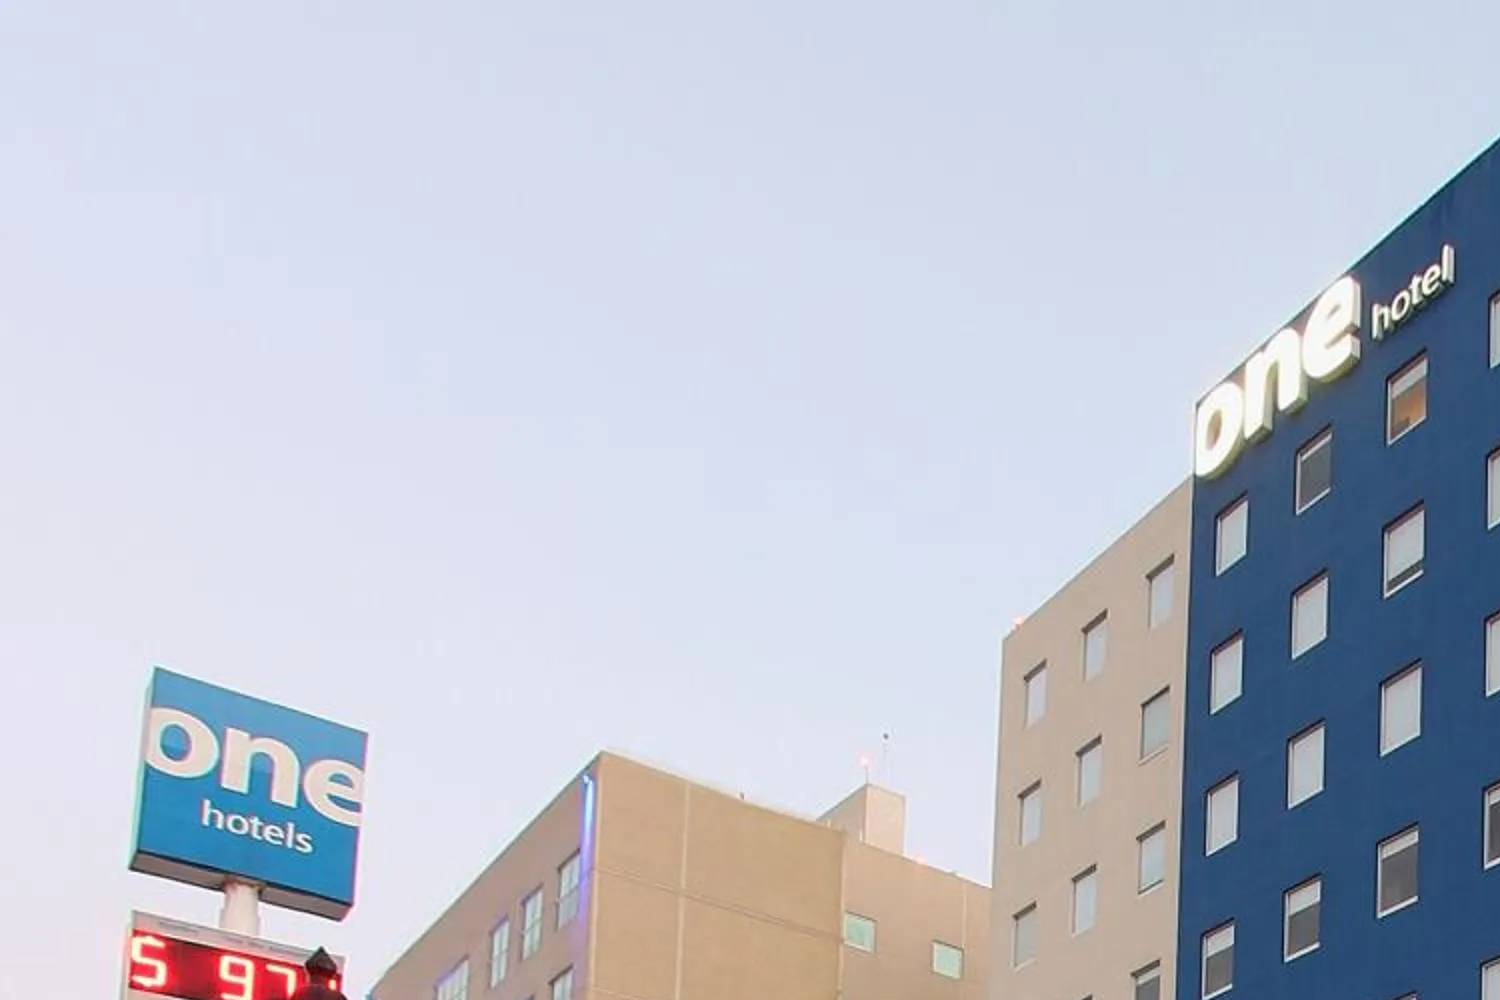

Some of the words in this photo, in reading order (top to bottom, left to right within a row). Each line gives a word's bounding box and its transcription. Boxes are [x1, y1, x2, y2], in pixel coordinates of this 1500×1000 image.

[1195, 275, 1361, 480] one
[1371, 244, 1455, 342] hotel
[145, 707, 364, 827] one
[202, 799, 314, 853] hotels
